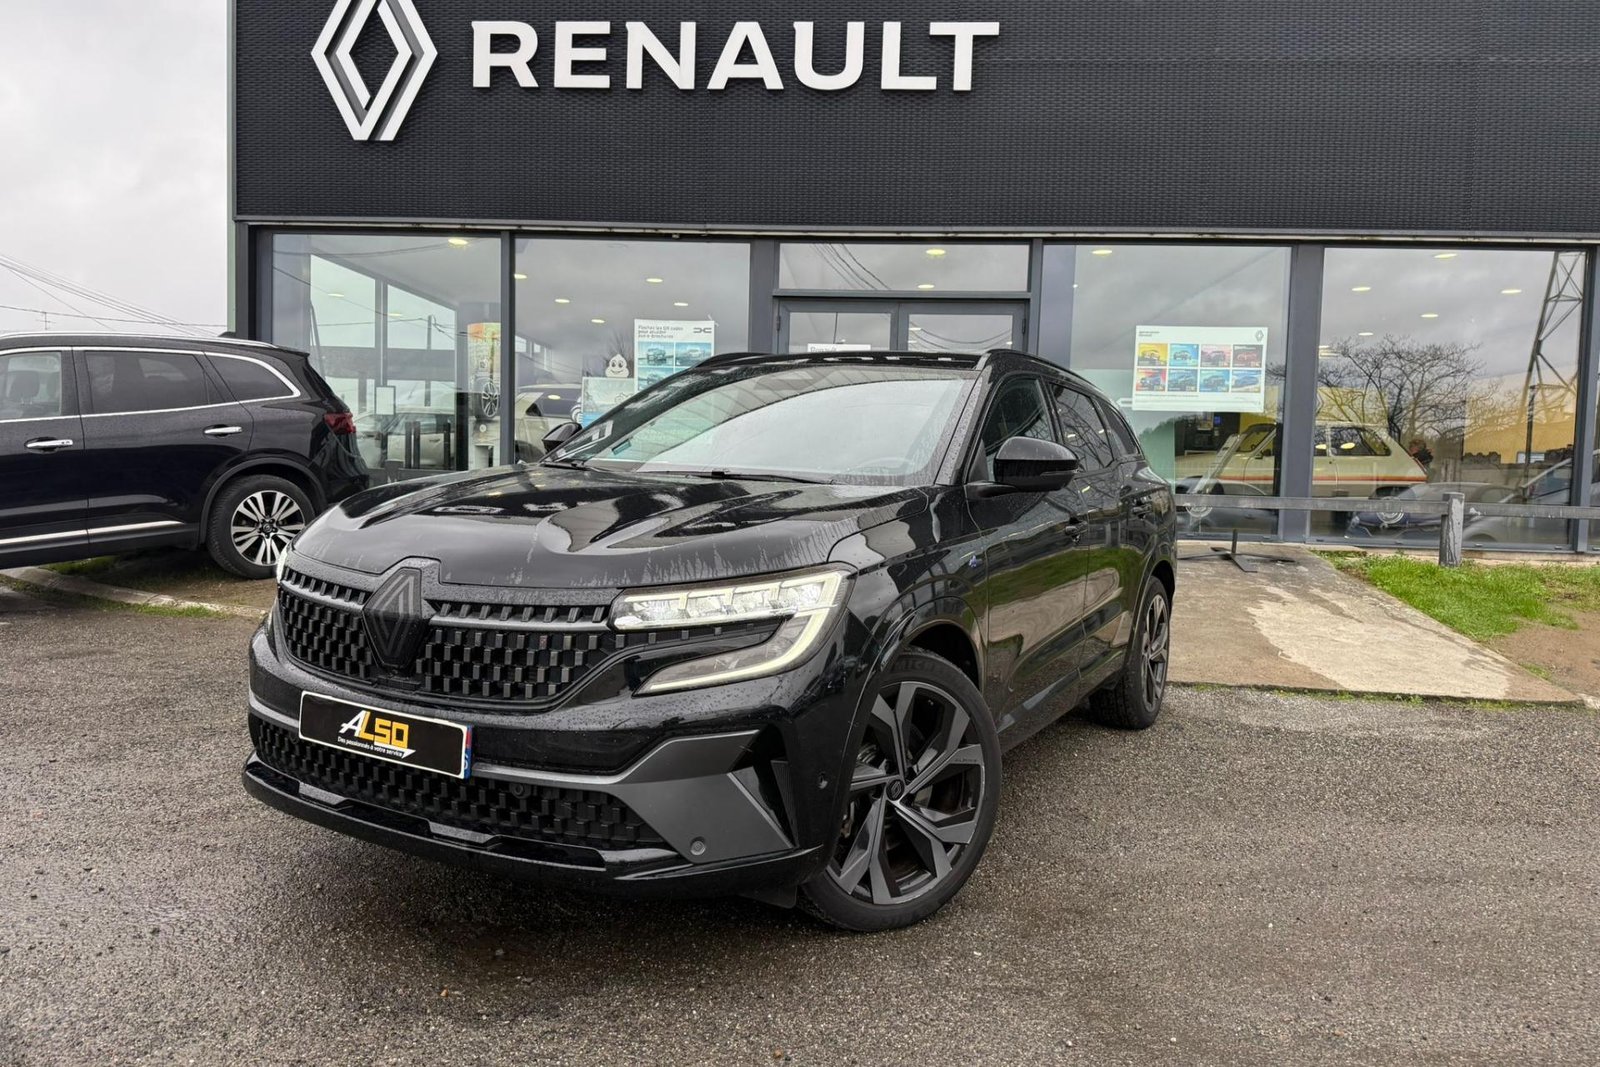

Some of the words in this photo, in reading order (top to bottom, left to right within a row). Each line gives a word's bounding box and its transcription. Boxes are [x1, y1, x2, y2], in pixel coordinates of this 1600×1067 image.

[471, 20, 1000, 91] RENAULT
[338, 709, 409, 749] ALSO
[346, 738, 369, 750] passionnés
[386, 749, 403, 757] service
